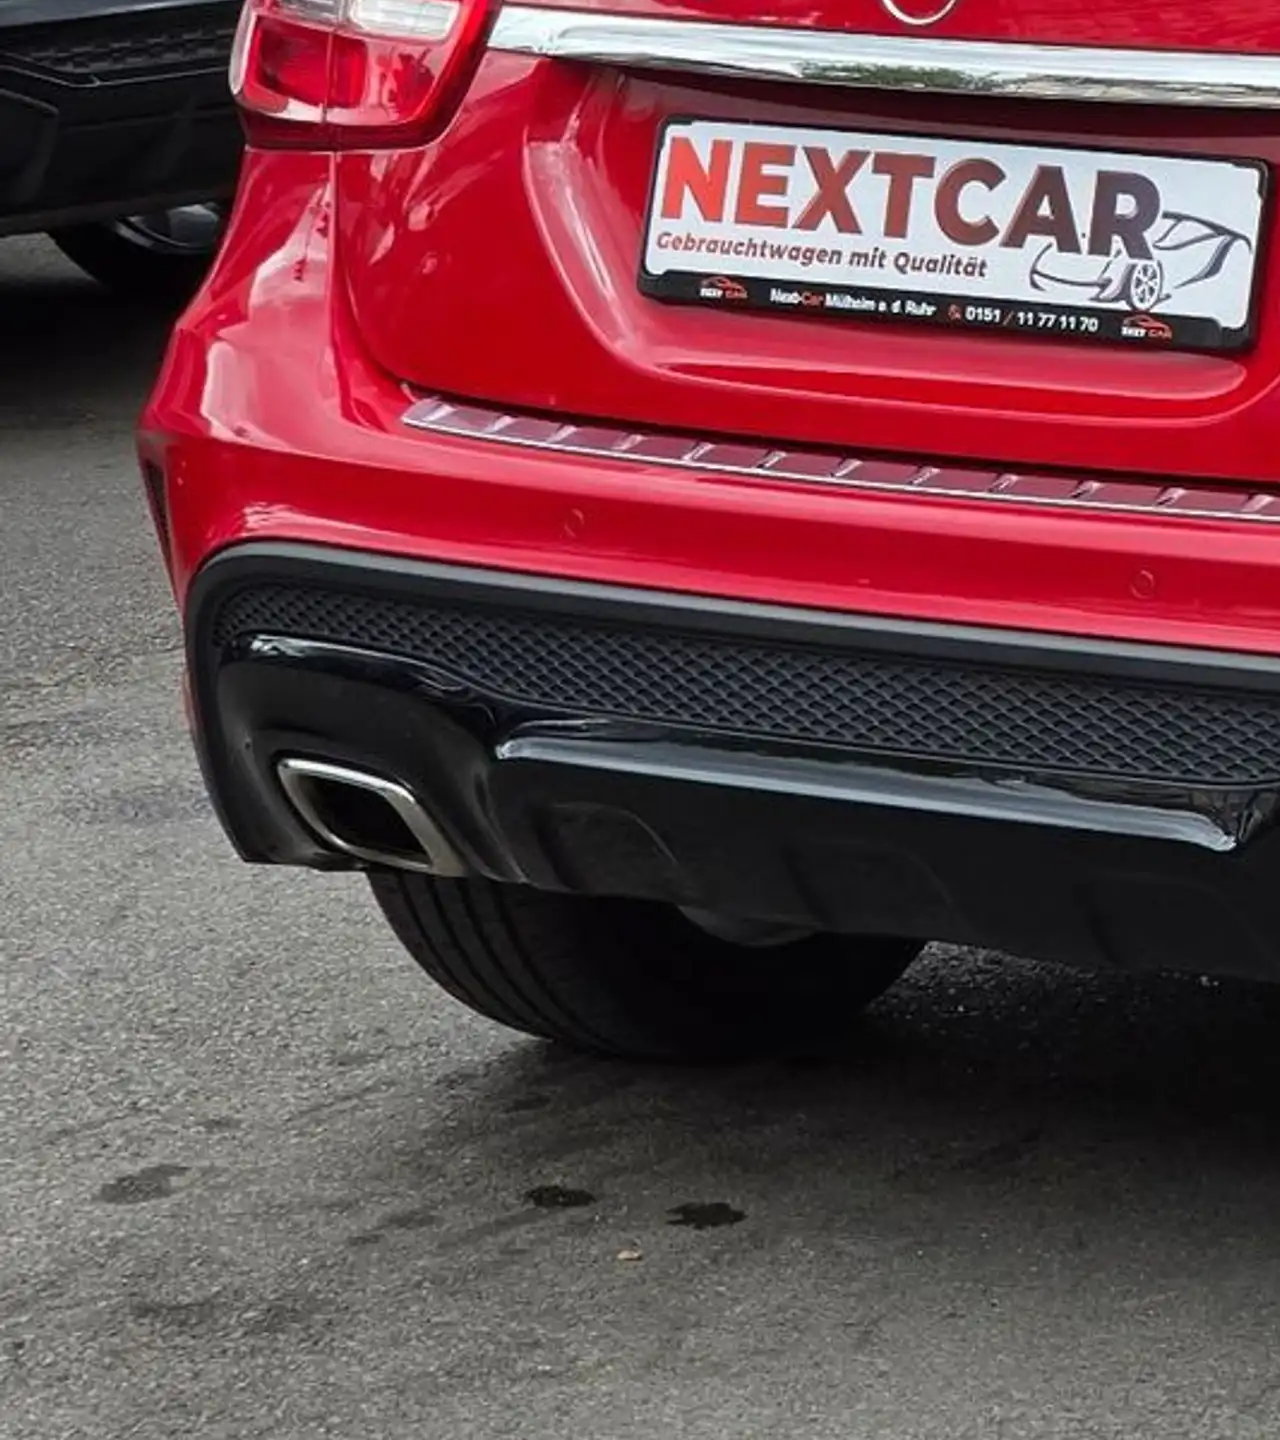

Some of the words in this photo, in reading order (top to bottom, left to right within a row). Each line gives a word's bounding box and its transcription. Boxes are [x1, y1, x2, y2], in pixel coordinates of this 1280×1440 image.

[660, 136, 1162, 259] NEXTCAR
[656, 231, 843, 266] Gebrauchtwagen
[849, 246, 888, 268] mit
[893, 251, 988, 278] Qualität
[825, 292, 875, 311] Mülheim
[905, 300, 936, 316] Ruhr
[965, 306, 1000, 323] 0151
[1017, 312, 1034, 326] 11
[1037, 313, 1056, 328] 77
[1059, 315, 1076, 330] 11
[1080, 316, 1099, 332] 70
